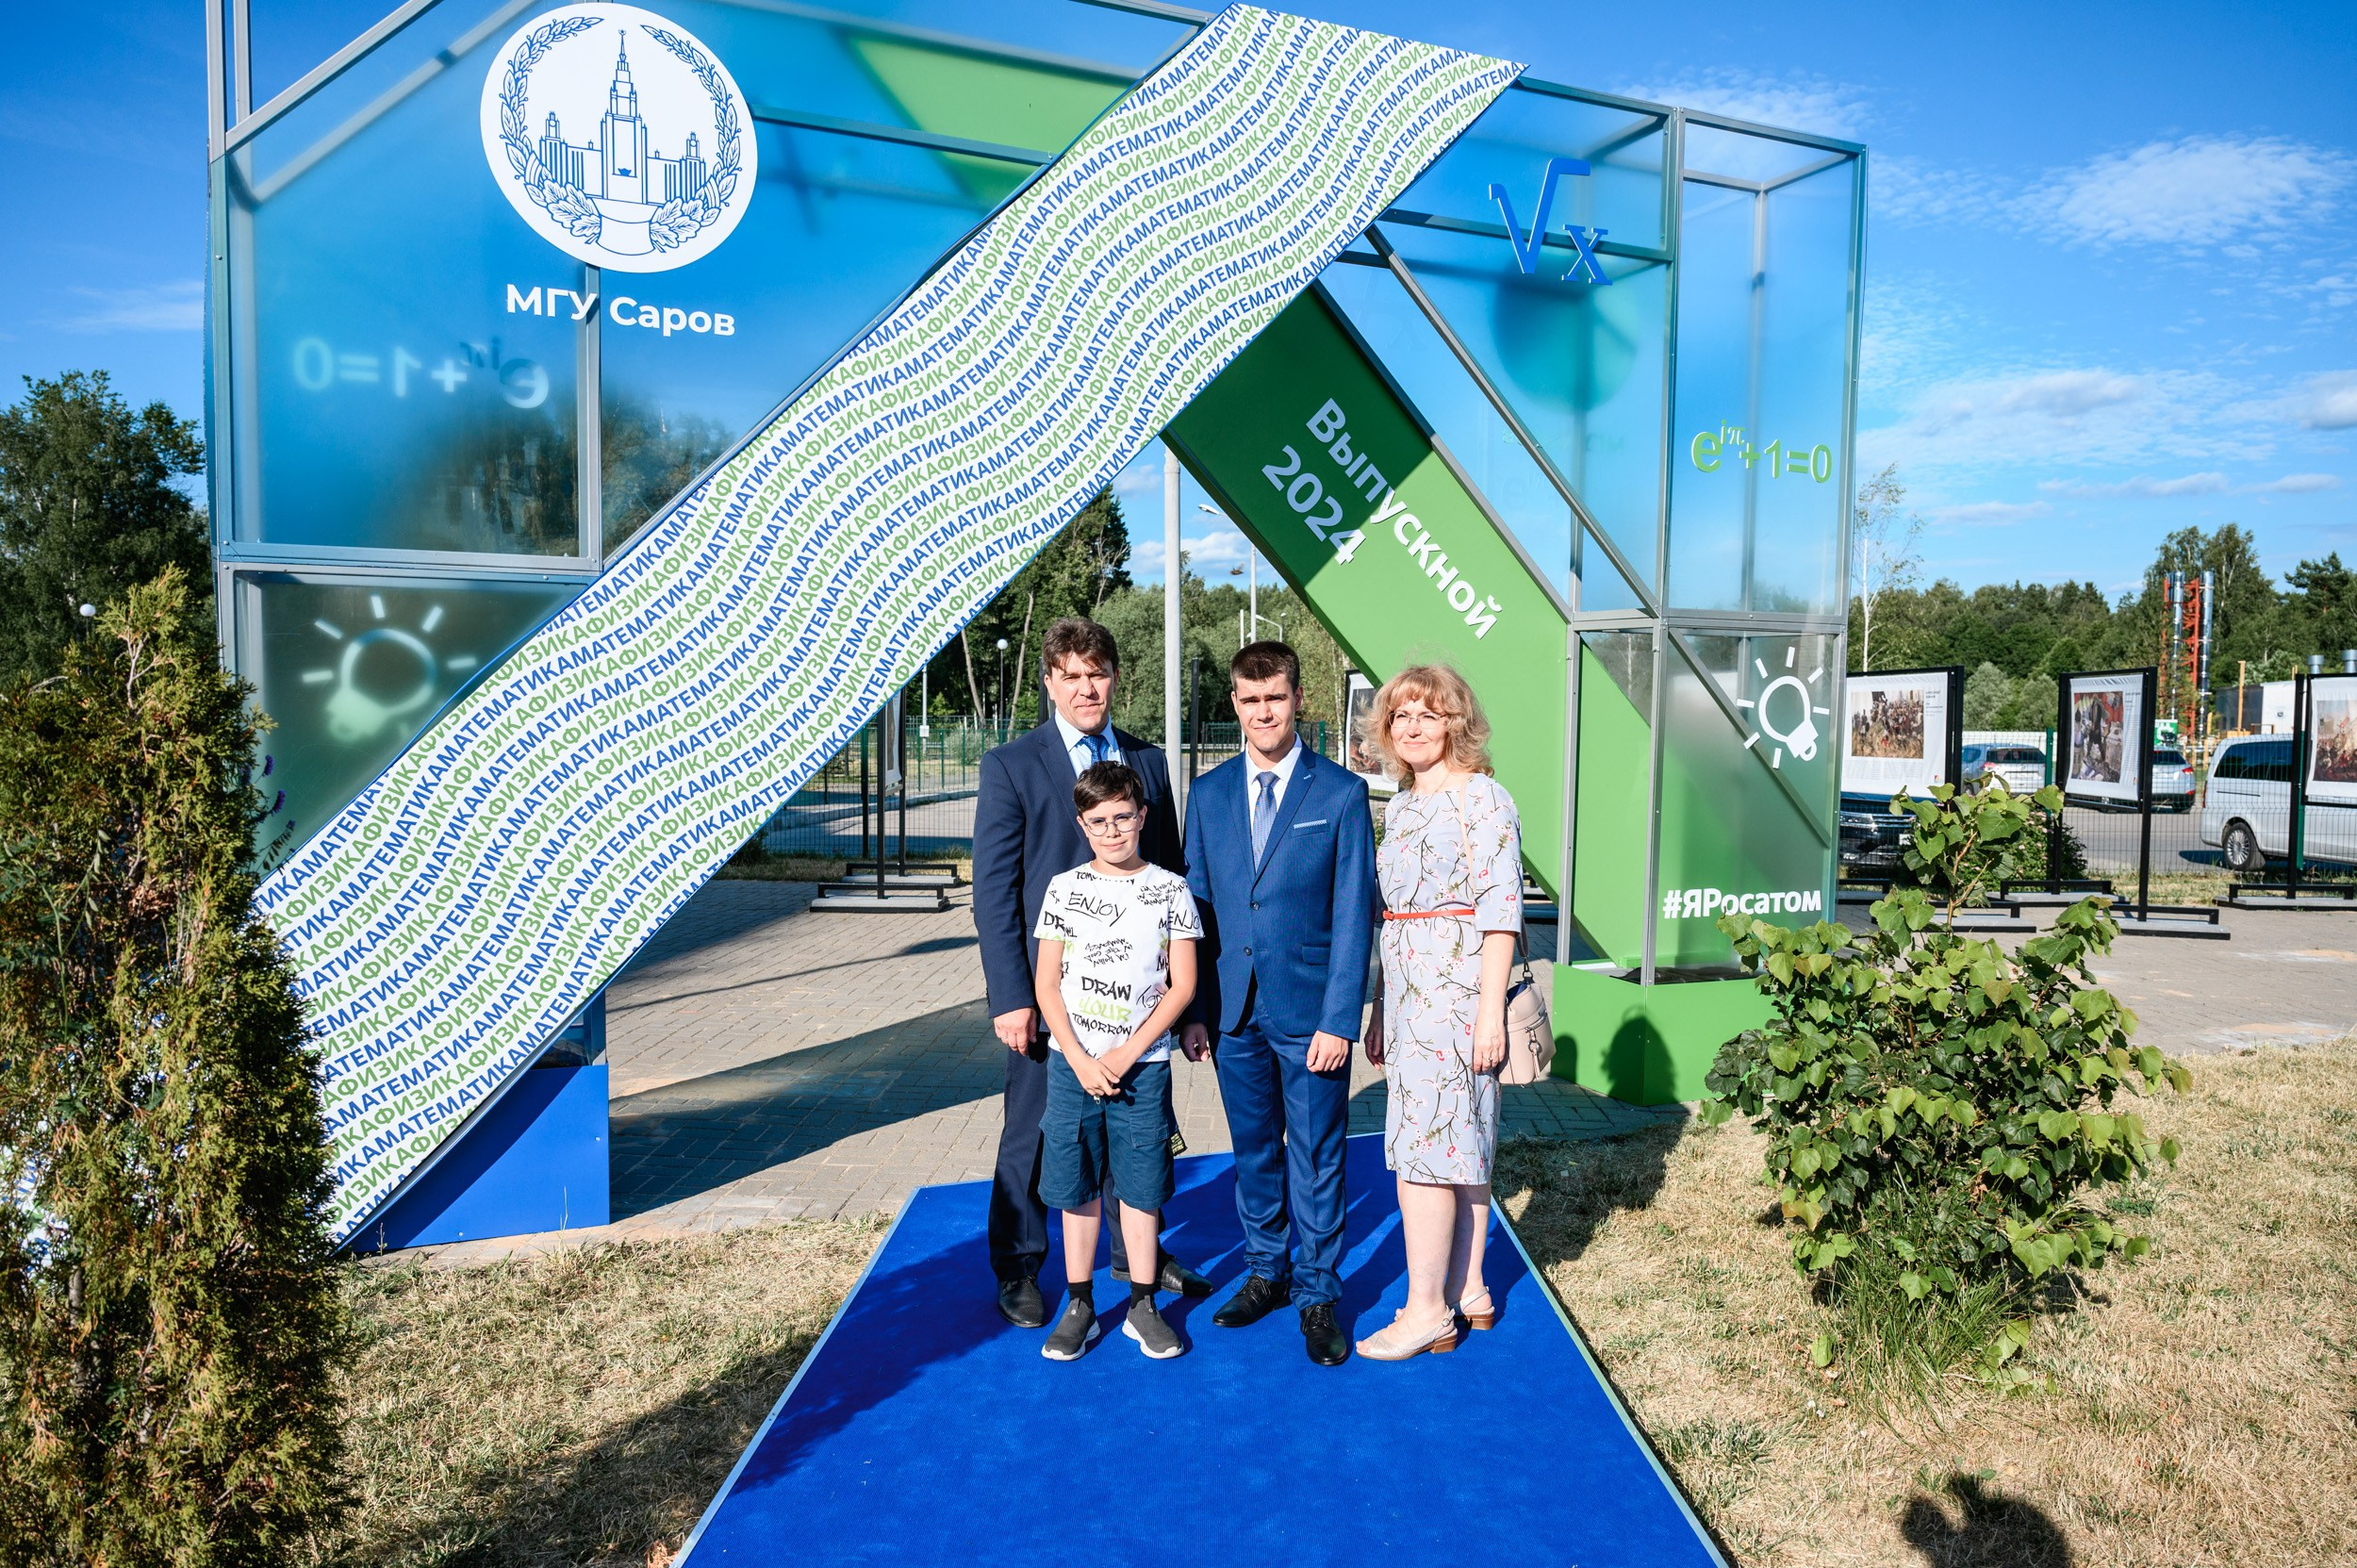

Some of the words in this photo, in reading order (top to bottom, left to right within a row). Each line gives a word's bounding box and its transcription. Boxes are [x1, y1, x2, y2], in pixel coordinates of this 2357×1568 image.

[506, 284, 598, 321] МГУ
[608, 296, 735, 337] Саров
[1261, 445, 1366, 566] 2024
[1305, 397, 1503, 639] Выпускной
[1068, 892, 1127, 928] ENJOY
[1662, 887, 1821, 919] #ЯРосатом
[1080, 976, 1131, 1001] DRAW
[1072, 1013, 1131, 1036] TOMORROW
[1079, 997, 1131, 1022] YOUR
